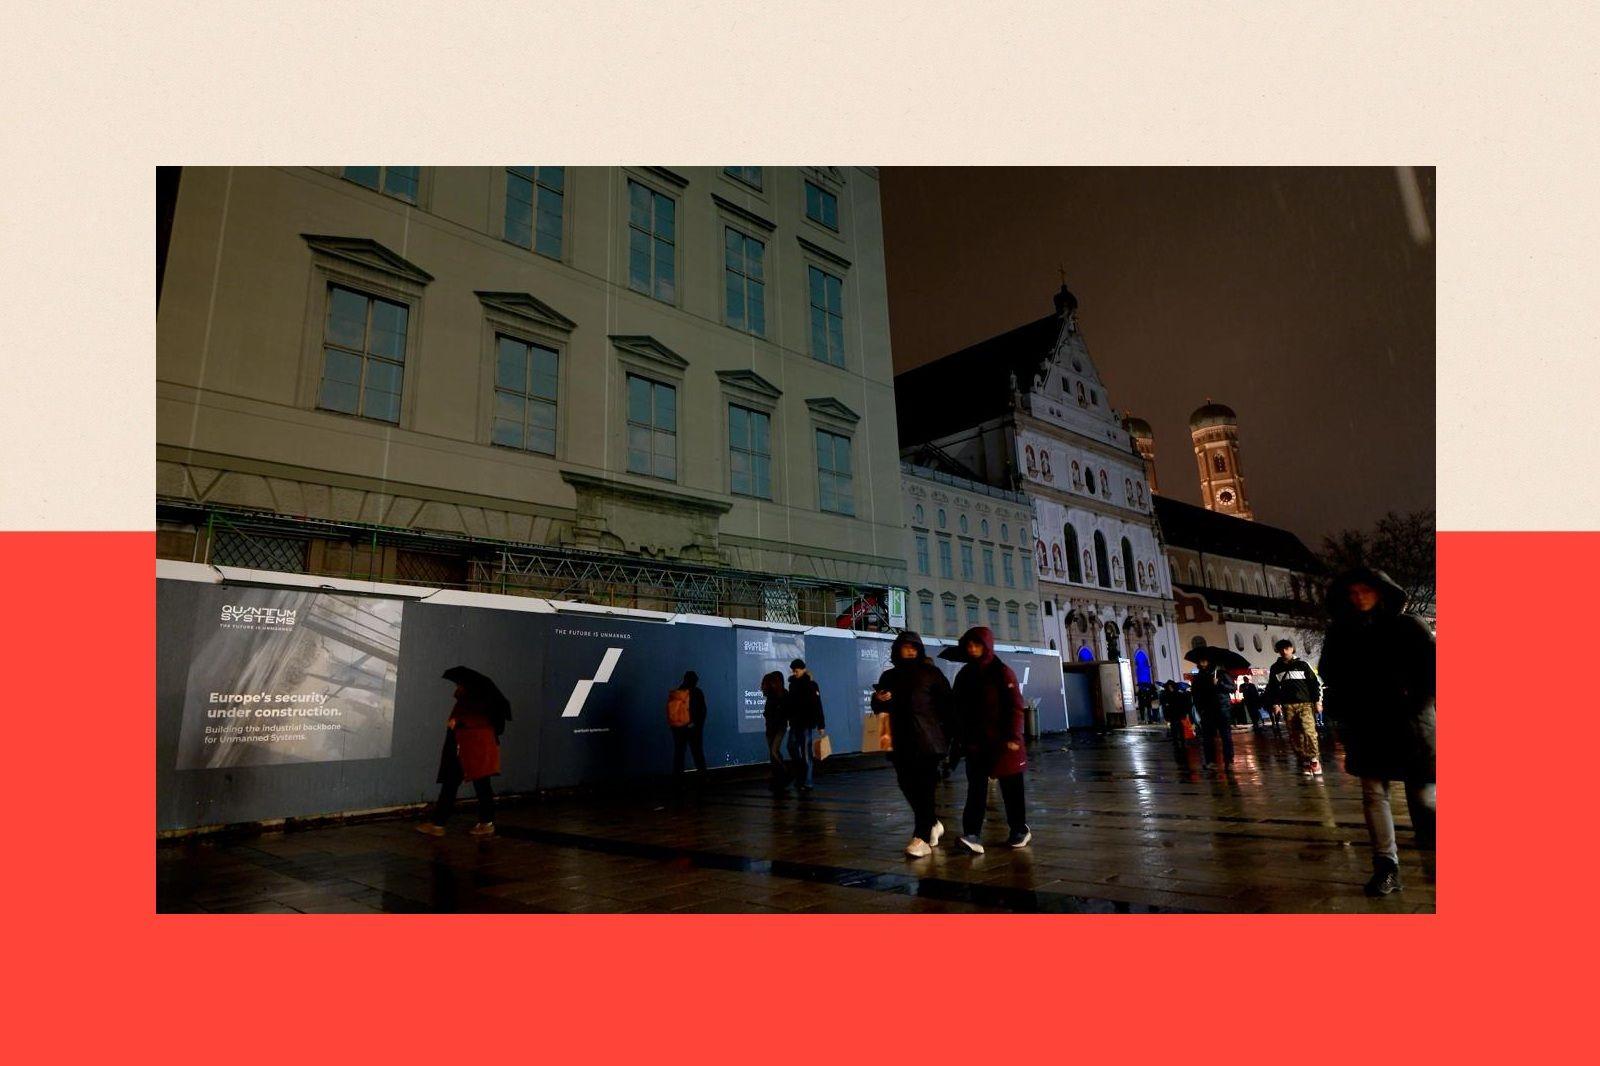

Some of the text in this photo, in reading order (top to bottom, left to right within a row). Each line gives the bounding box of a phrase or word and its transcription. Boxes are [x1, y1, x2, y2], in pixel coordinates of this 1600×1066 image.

[222, 605, 296, 618] QUANTUM
[220, 613, 295, 625] SYSTEMS
[209, 692, 328, 704] Europe's security
[207, 706, 342, 718] under construction.
[205, 726, 243, 734] Building
[204, 736, 216, 744] for
[220, 735, 268, 743] Unmanned
